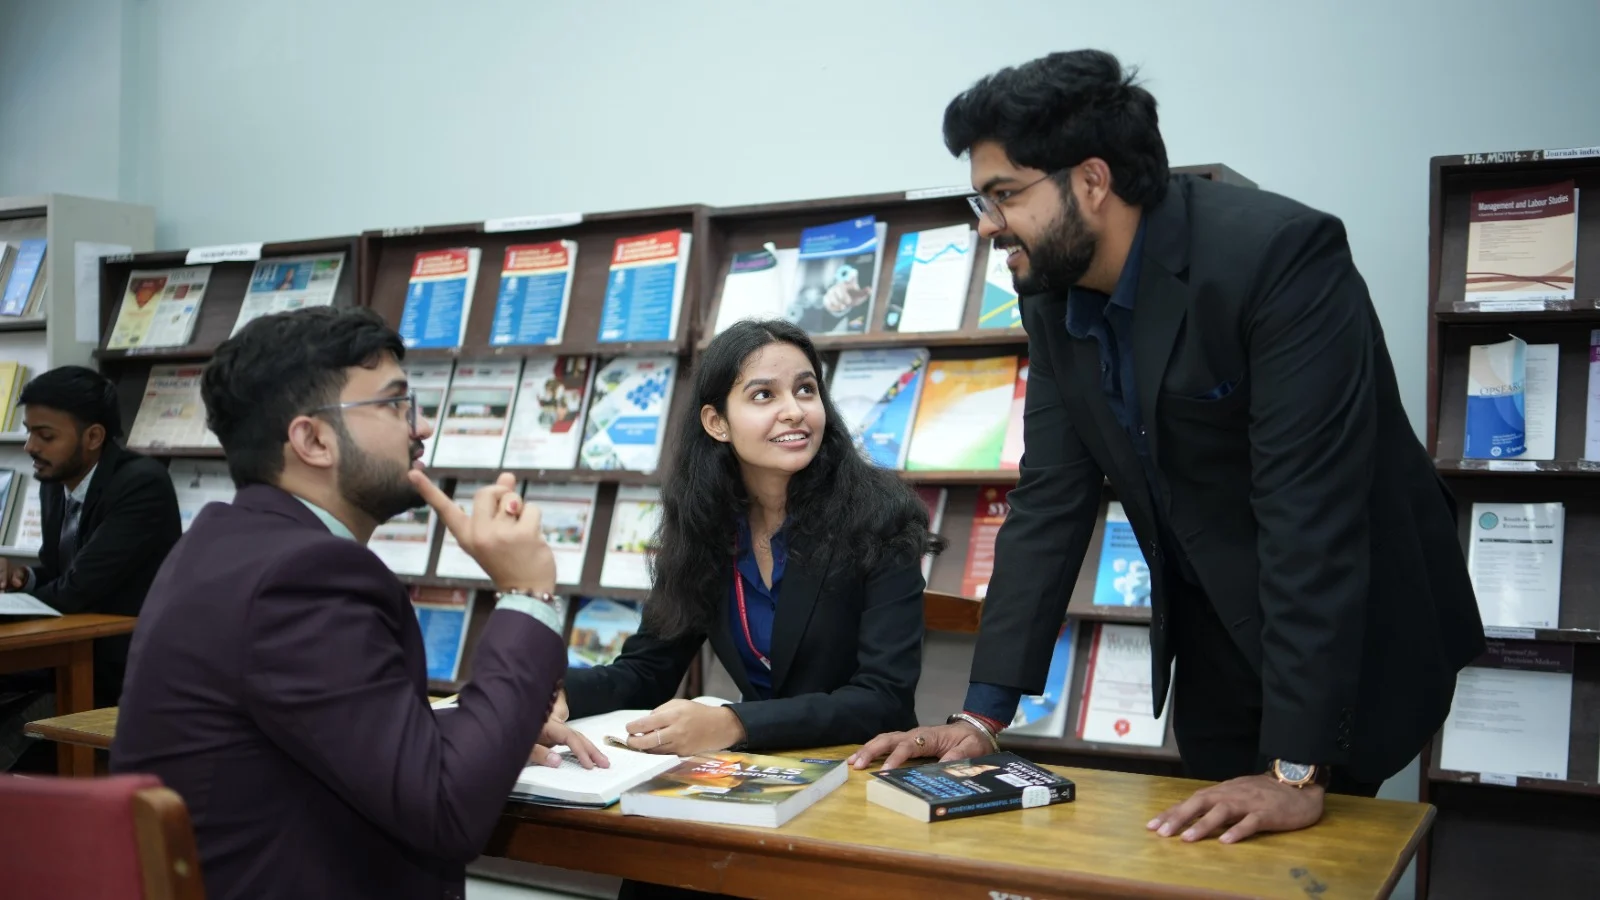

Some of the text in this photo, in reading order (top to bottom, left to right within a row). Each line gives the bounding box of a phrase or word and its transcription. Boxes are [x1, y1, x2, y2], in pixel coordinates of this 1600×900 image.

[1545, 149, 1578, 158] Journals
[1478, 194, 1569, 211] Management and Labour Studies
[692, 766, 796, 781] Management
[700, 760, 805, 776] SALES
[947, 803, 975, 814] ACHIEVING
[975, 799, 1009, 811] MEANINGFUL
